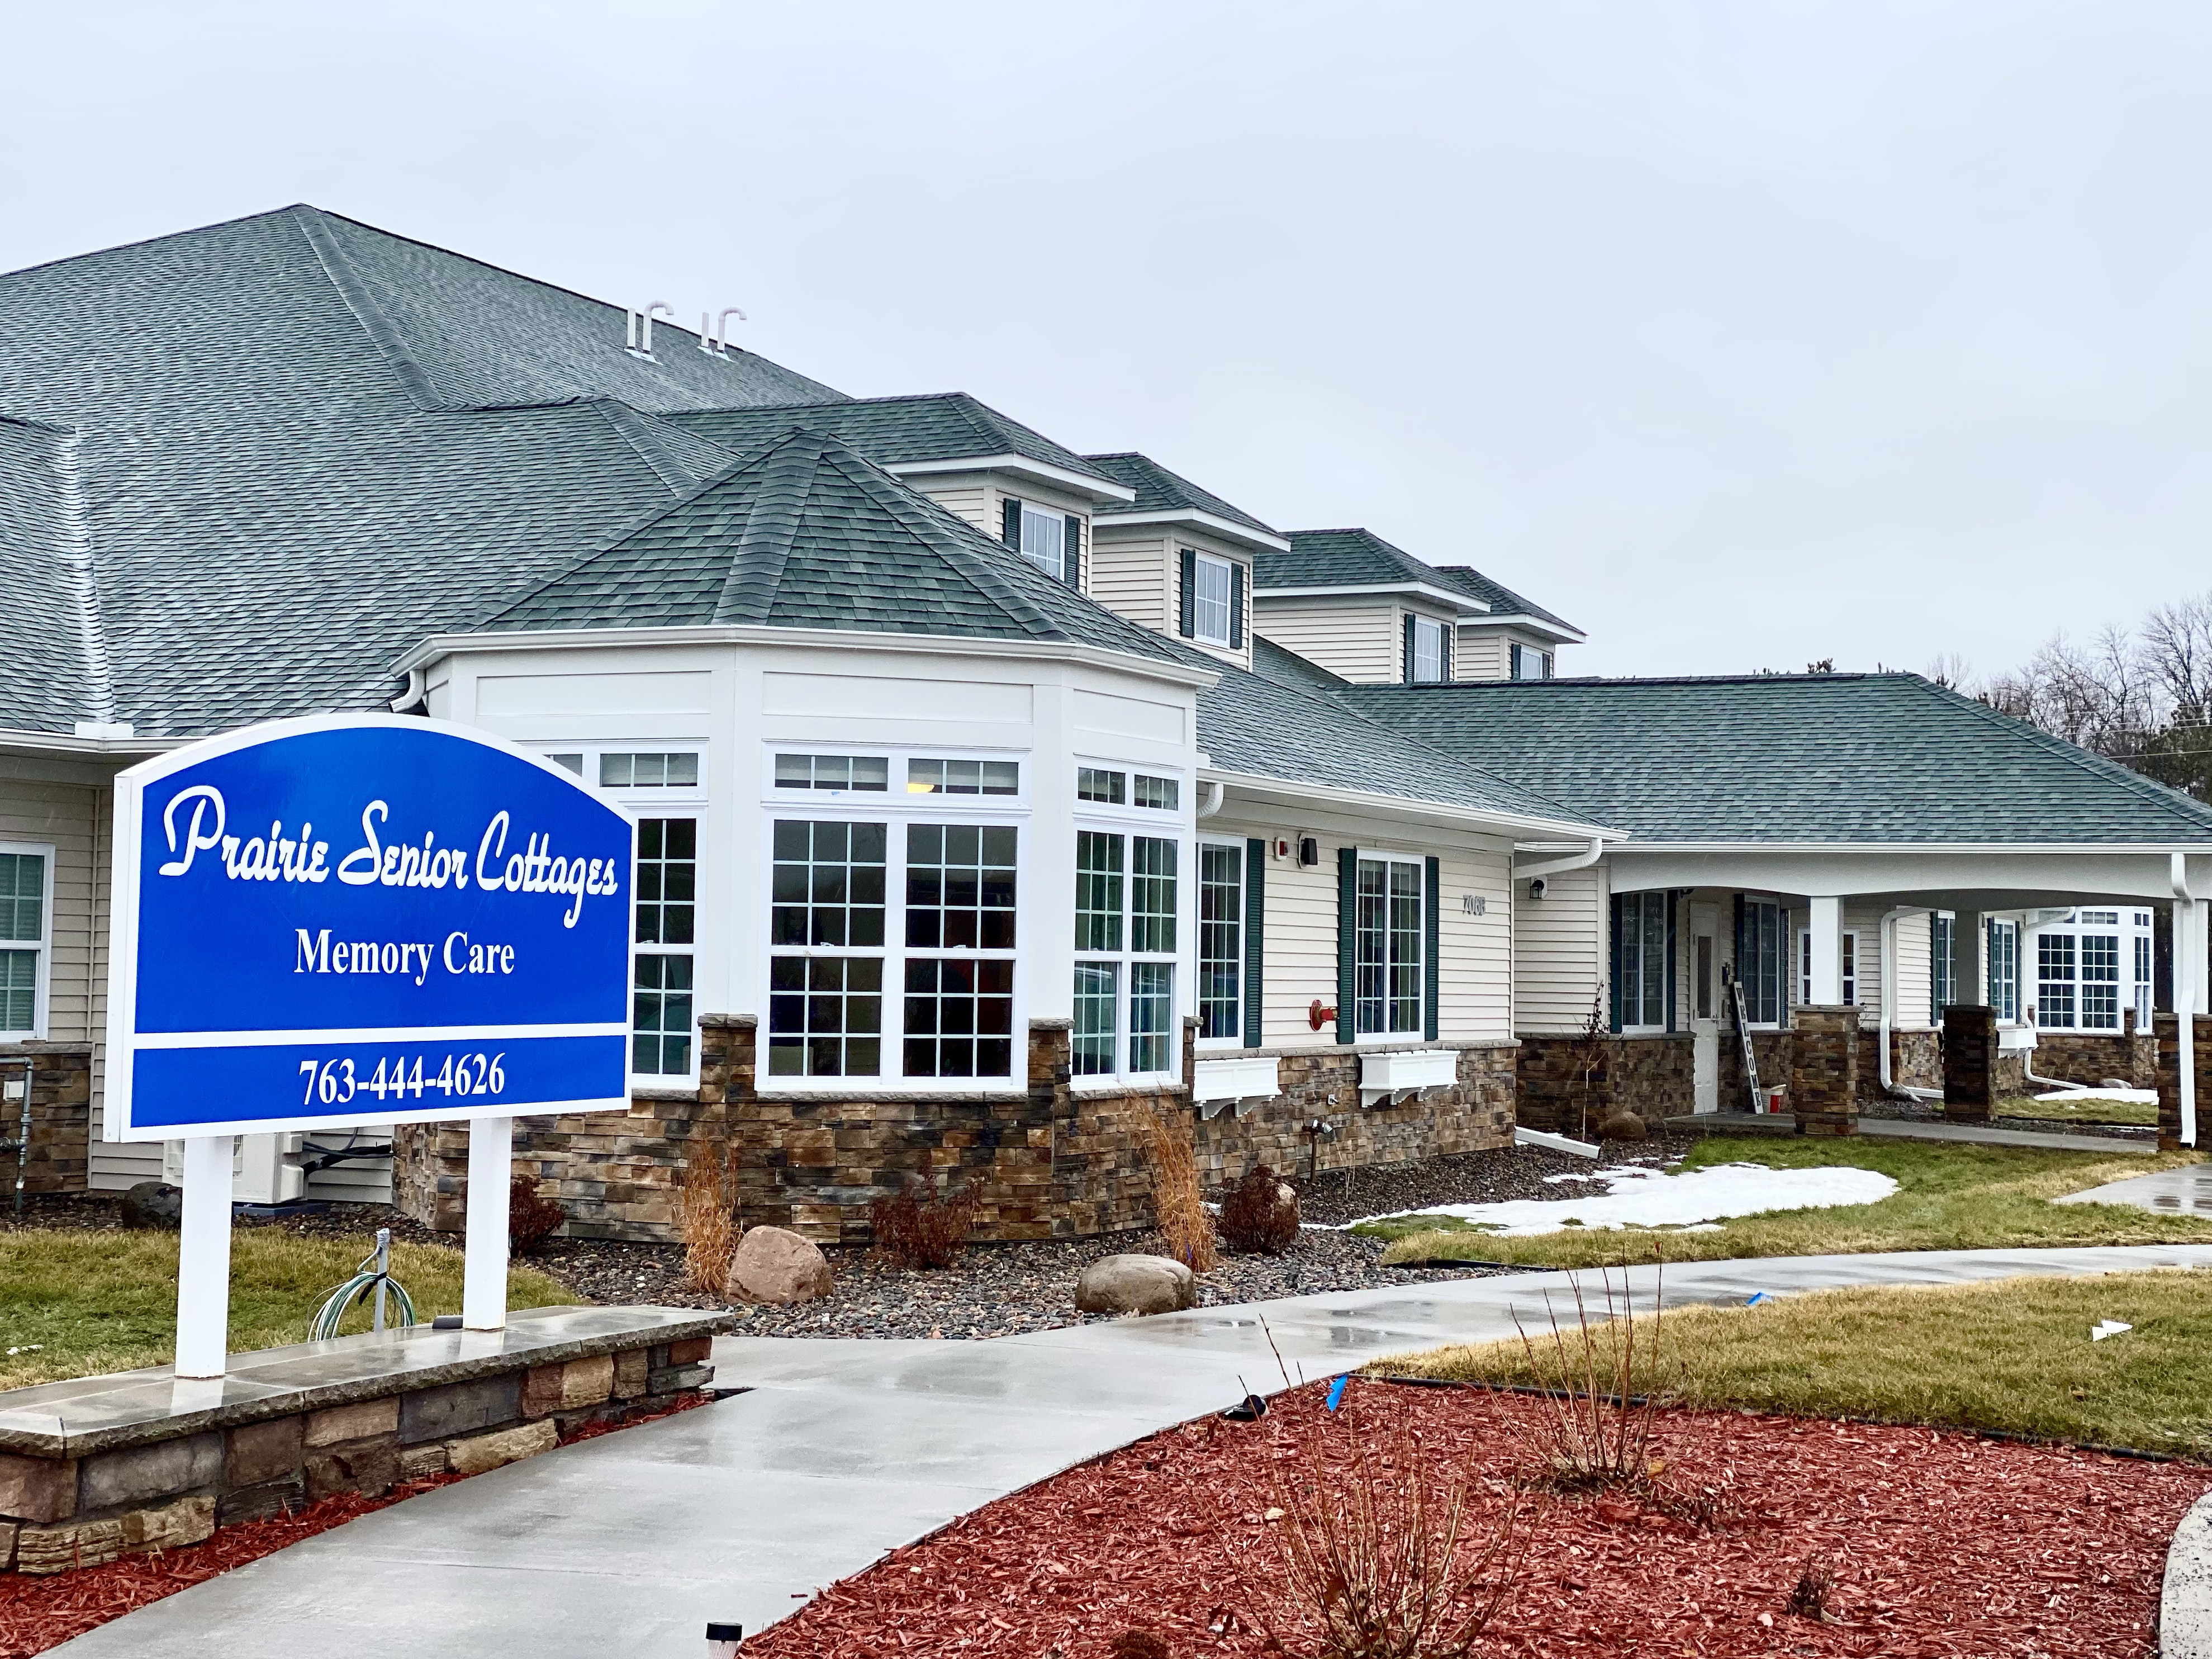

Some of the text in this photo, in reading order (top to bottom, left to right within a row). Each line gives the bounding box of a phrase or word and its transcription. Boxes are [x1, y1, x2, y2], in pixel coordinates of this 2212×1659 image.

[159, 785, 618, 928] Prairie Senior Cottages
[293, 928, 515, 986] Memory Care
[299, 1052, 505, 1105] 763-444-4626
[1736, 988, 1761, 1106] WELCOME
